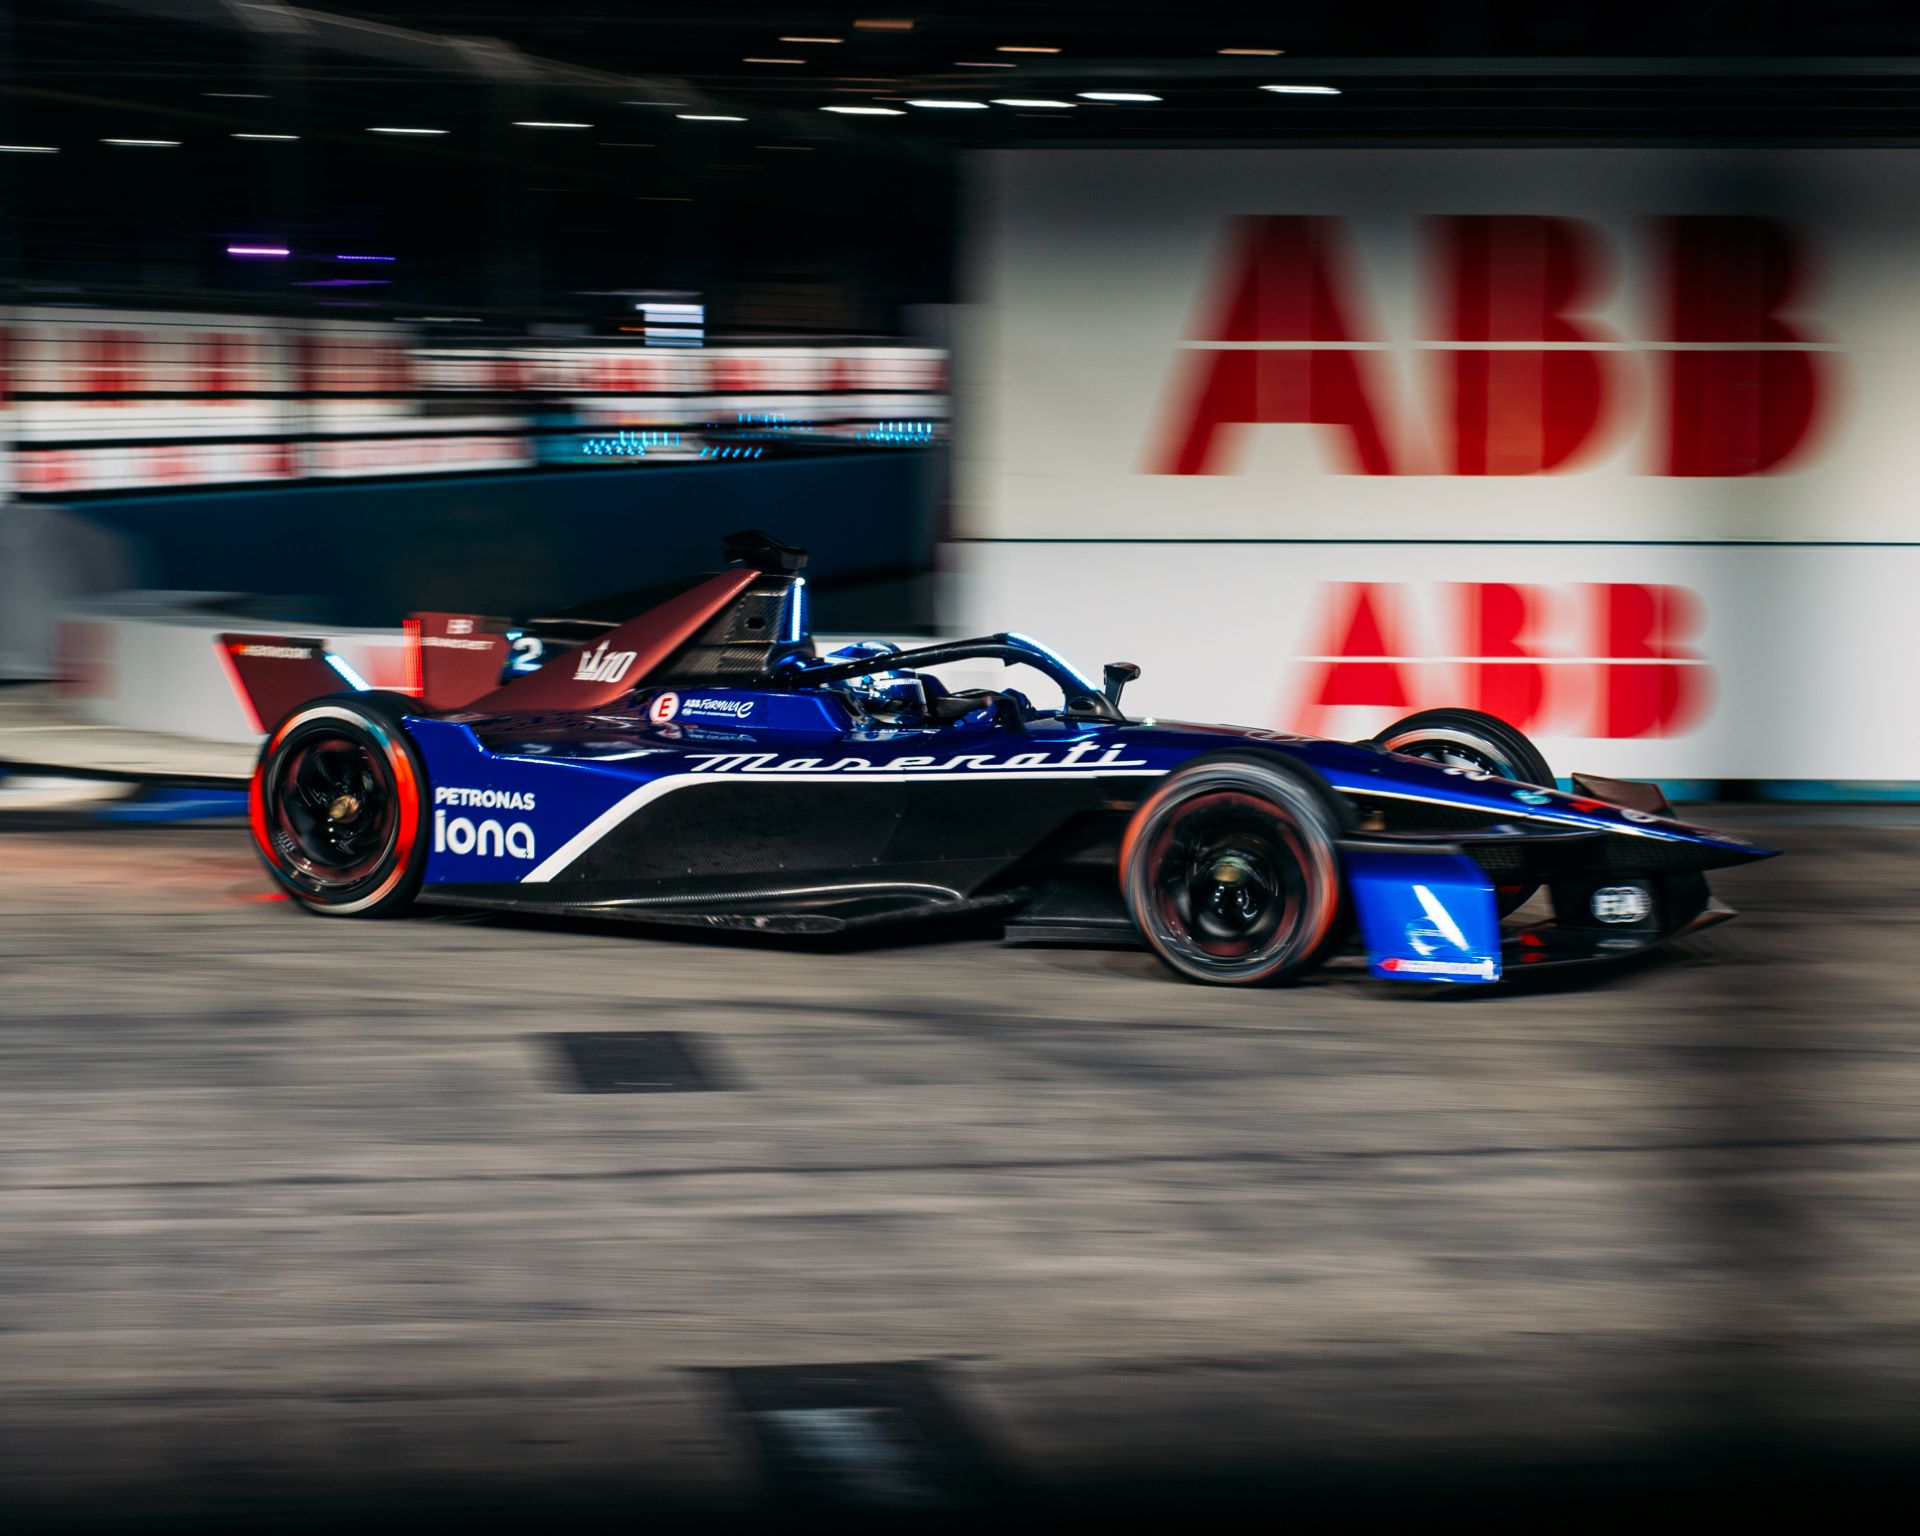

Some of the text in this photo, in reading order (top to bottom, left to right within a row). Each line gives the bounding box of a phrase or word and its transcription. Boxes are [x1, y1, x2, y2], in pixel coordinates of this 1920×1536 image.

[1140, 215, 1850, 476] ABB
[512, 637, 544, 671] 2
[1288, 581, 1714, 738] ABB
[658, 698, 673, 717] E
[699, 699, 740, 712] FORMULA
[684, 741, 1147, 772] Maserati
[434, 786, 536, 811] PETRONAS
[434, 809, 535, 860] iona
